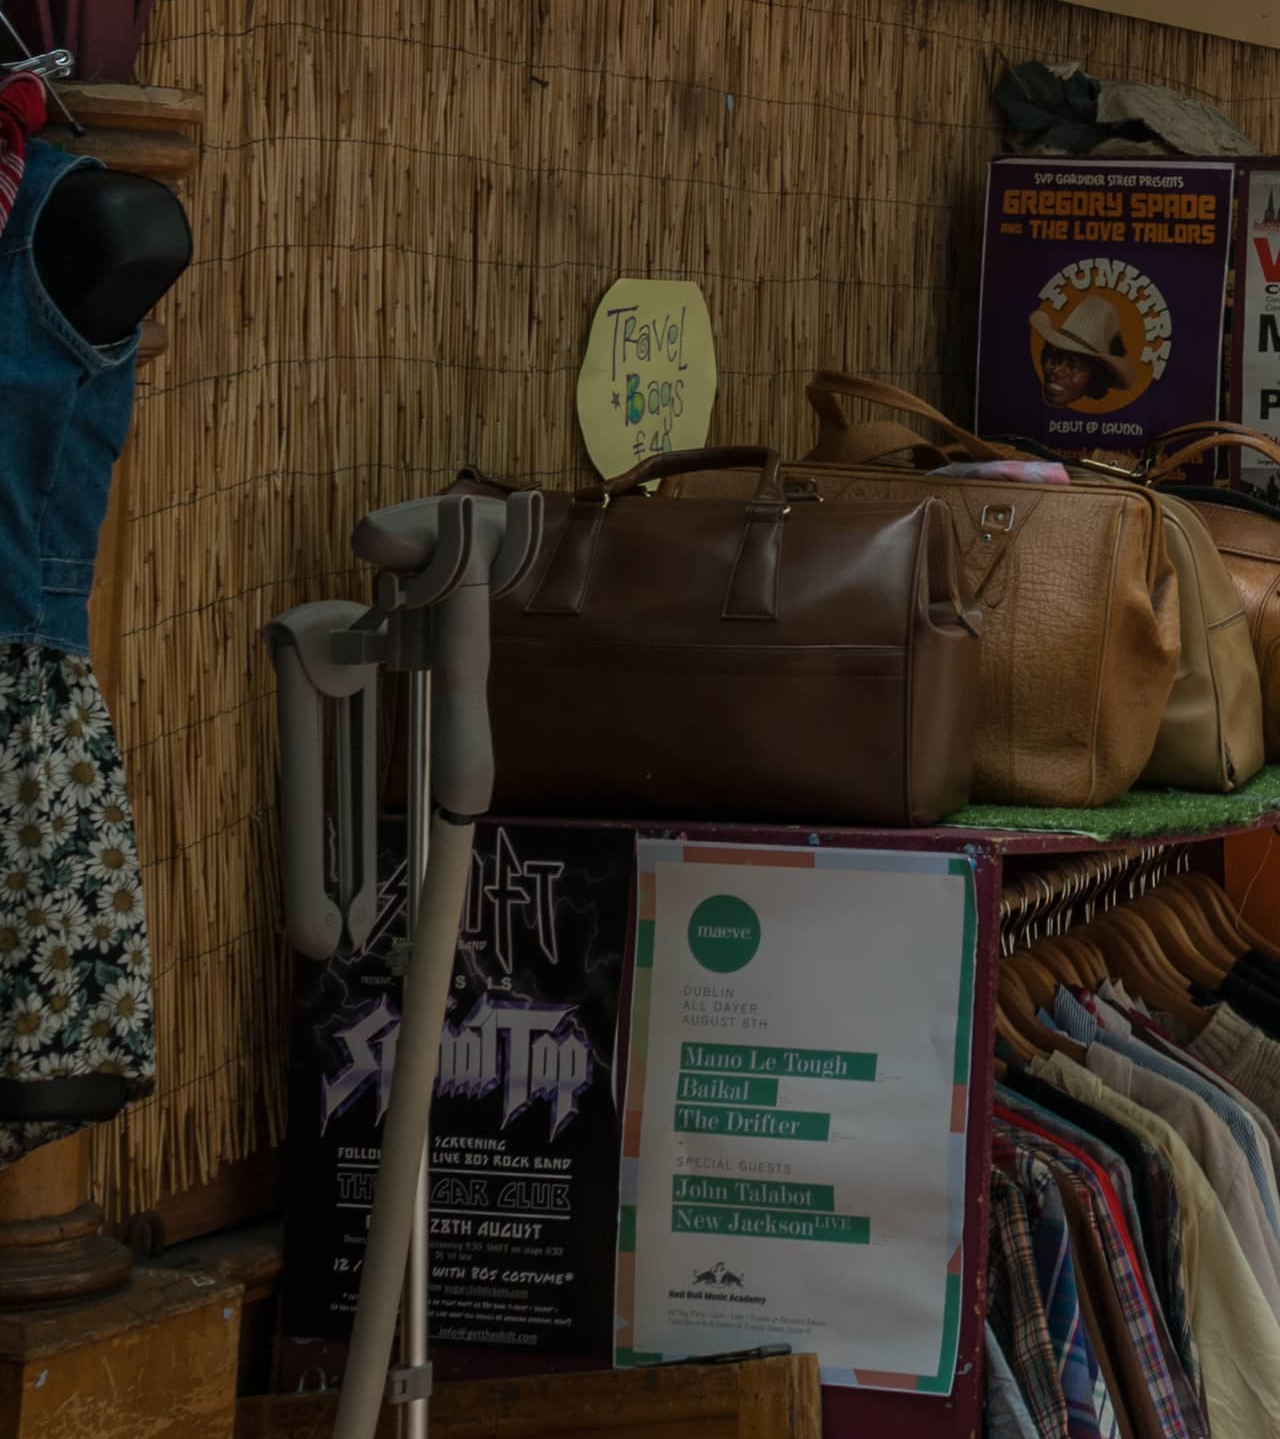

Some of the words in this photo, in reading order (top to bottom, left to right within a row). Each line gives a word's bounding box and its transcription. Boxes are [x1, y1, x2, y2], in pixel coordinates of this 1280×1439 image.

[1107, 176, 1137, 187] STREET
[1038, 257, 1173, 382] FUNKTRY
[1049, 420, 1084, 433] DEBUT
[683, 985, 735, 999] DUBLIN
[682, 1000, 707, 1012] ALL
[714, 1002, 758, 1014] DAYER
[682, 1015, 737, 1028] AUGUST
[684, 1046, 743, 1068] Mano
[748, 1050, 777, 1070] Le
[783, 1052, 848, 1077] Tough
[681, 1078, 750, 1100] Baikal
[678, 1108, 720, 1129] The
[726, 1111, 800, 1135] Drifter
[434, 1136, 506, 1151] SCREENING
[432, 1152, 460, 1164] LIVE
[493, 1155, 530, 1168] ROCK
[534, 1157, 572, 1170] BAND
[676, 1156, 732, 1171] SPECIAL
[739, 1161, 792, 1175] GUESTS
[497, 1180, 571, 1211] CLUB
[675, 1178, 728, 1200] John
[734, 1182, 813, 1206] Talabot
[676, 1206, 722, 1230] New
[477, 1221, 543, 1240] AUGUST
[432, 1266, 465, 1280] WITH
